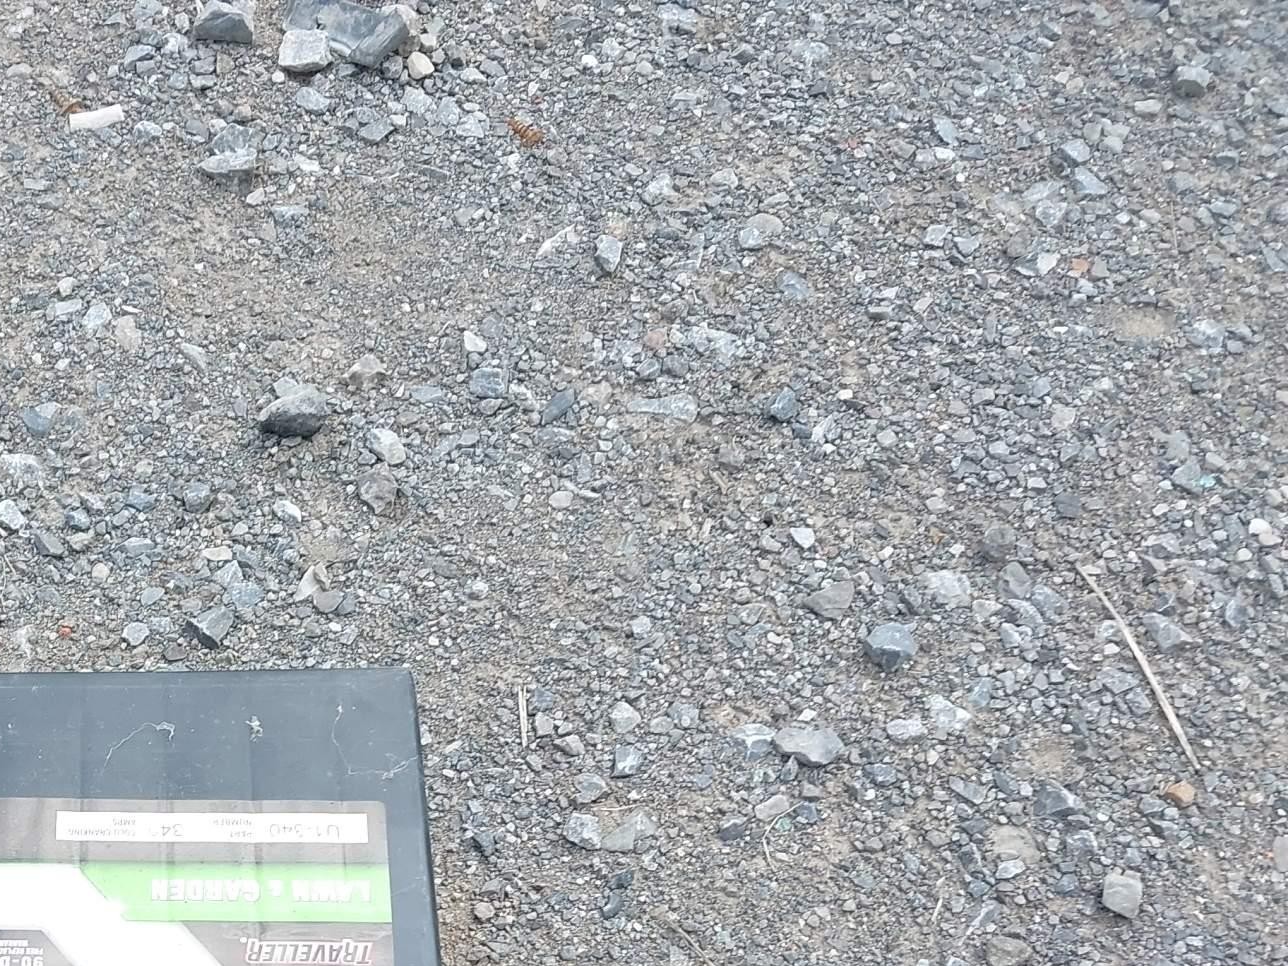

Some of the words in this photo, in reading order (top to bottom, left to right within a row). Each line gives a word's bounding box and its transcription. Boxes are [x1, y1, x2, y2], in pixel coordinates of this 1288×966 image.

[150, 880, 262, 902] GARDEN
[291, 880, 372, 902] LAWN
[243, 938, 373, 966] TRAVELLER
